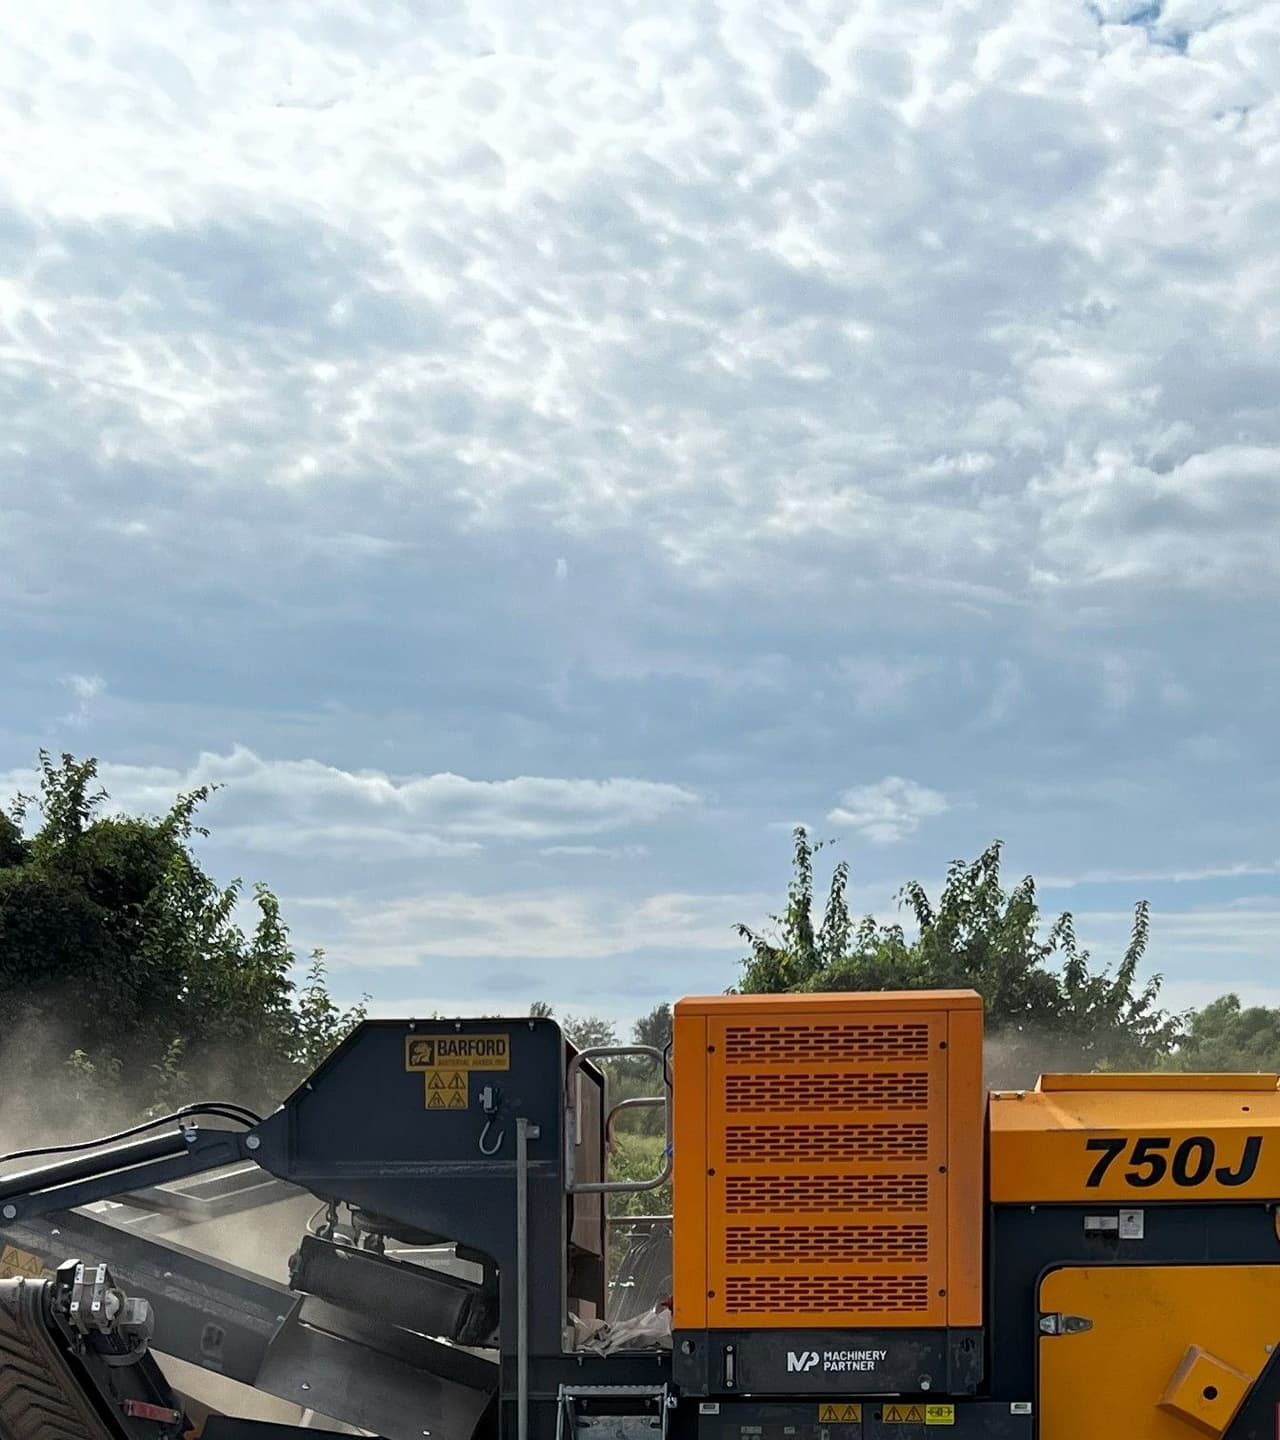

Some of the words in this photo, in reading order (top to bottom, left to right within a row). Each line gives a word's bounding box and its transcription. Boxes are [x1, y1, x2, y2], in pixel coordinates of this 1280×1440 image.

[438, 1039, 506, 1056] BARFORD
[1085, 1136, 1263, 1188] 750J
[787, 1351, 820, 1372] MP
[823, 1350, 887, 1361] MACHINERY
[823, 1361, 875, 1372] PARTNER
